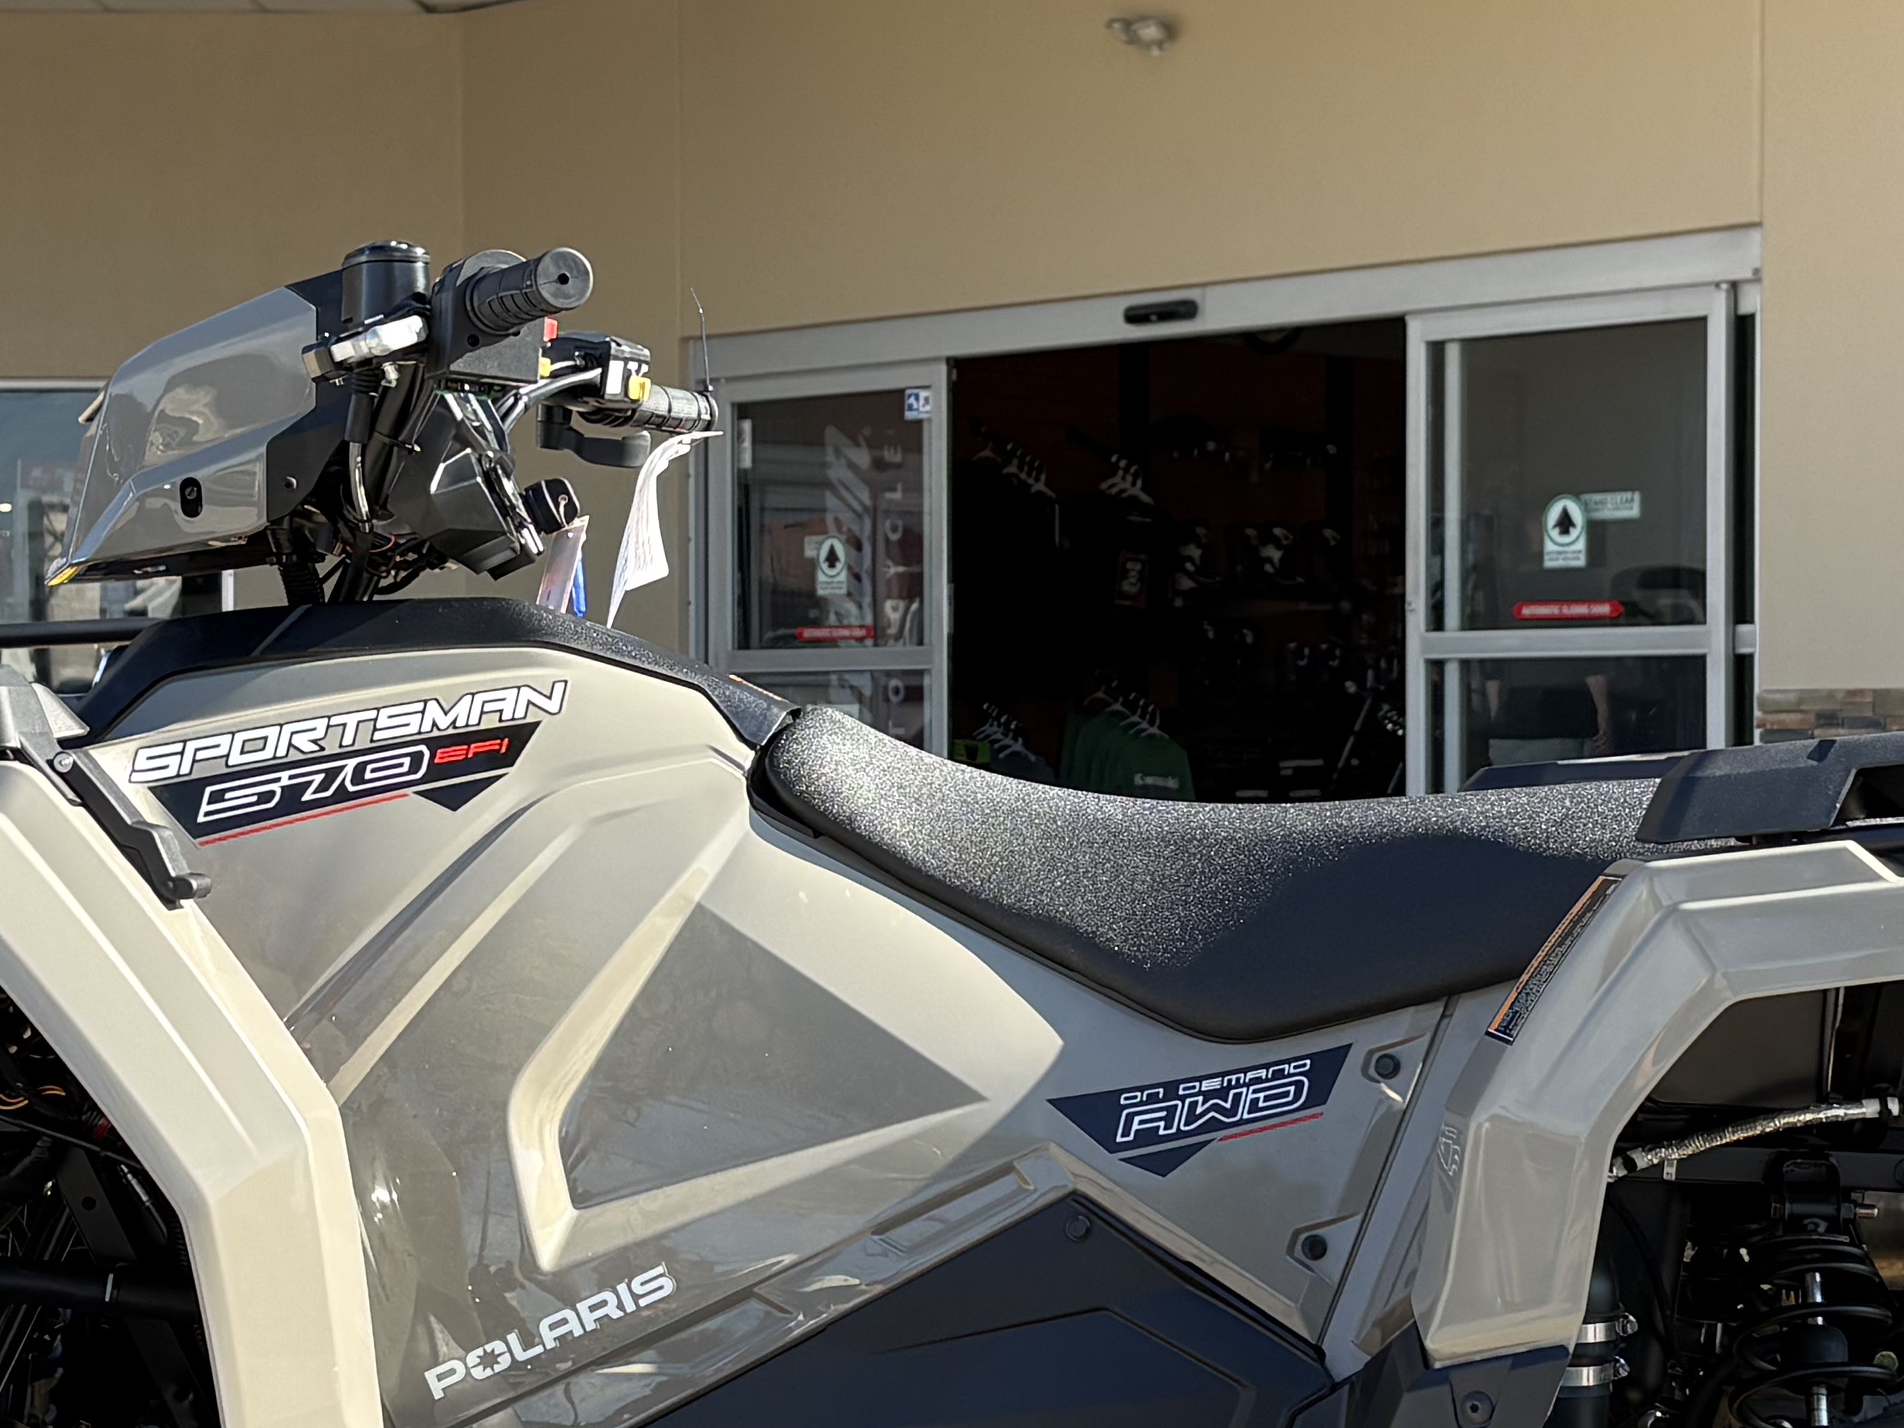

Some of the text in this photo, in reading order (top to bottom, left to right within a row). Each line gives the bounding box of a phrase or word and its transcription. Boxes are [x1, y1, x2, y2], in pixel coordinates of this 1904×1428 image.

[129, 679, 569, 783] SPORTSMAN
[197, 737, 510, 823] 570 EFI
[1115, 1075, 1310, 1143] AWD
[1119, 1058, 1311, 1106] ON DEMAND
[424, 1263, 677, 1402] POLARIS
